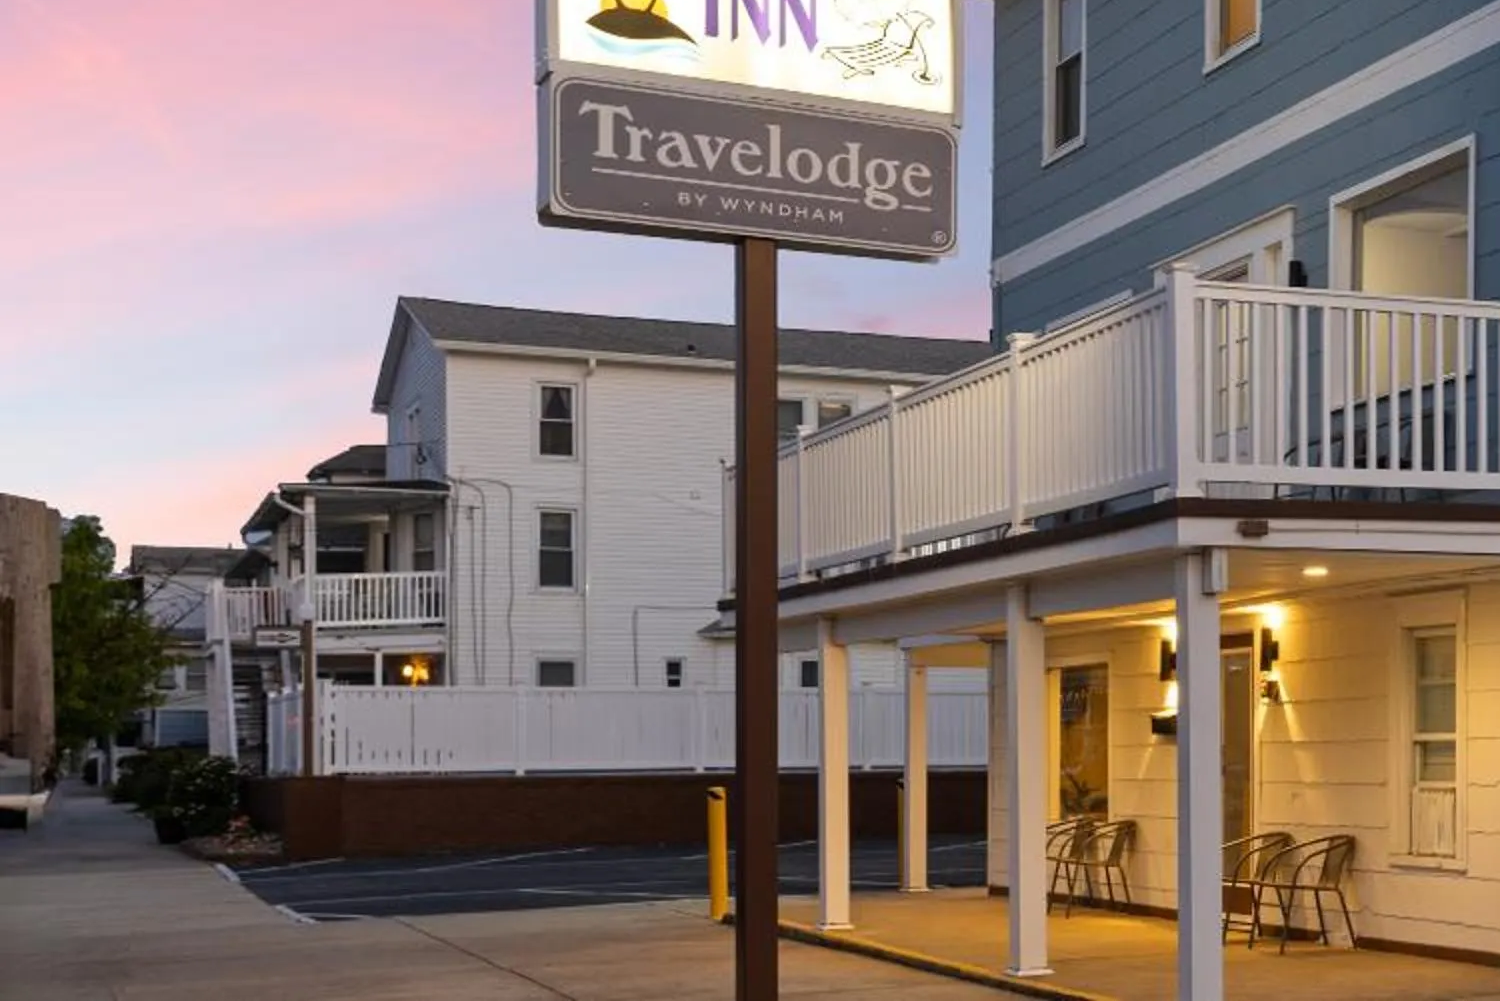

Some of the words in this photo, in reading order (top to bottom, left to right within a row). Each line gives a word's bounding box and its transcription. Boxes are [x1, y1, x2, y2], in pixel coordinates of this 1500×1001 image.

[578, 100, 933, 211] Travelodge
[677, 191, 708, 207] BY
[720, 198, 844, 223] WYNDHAM
